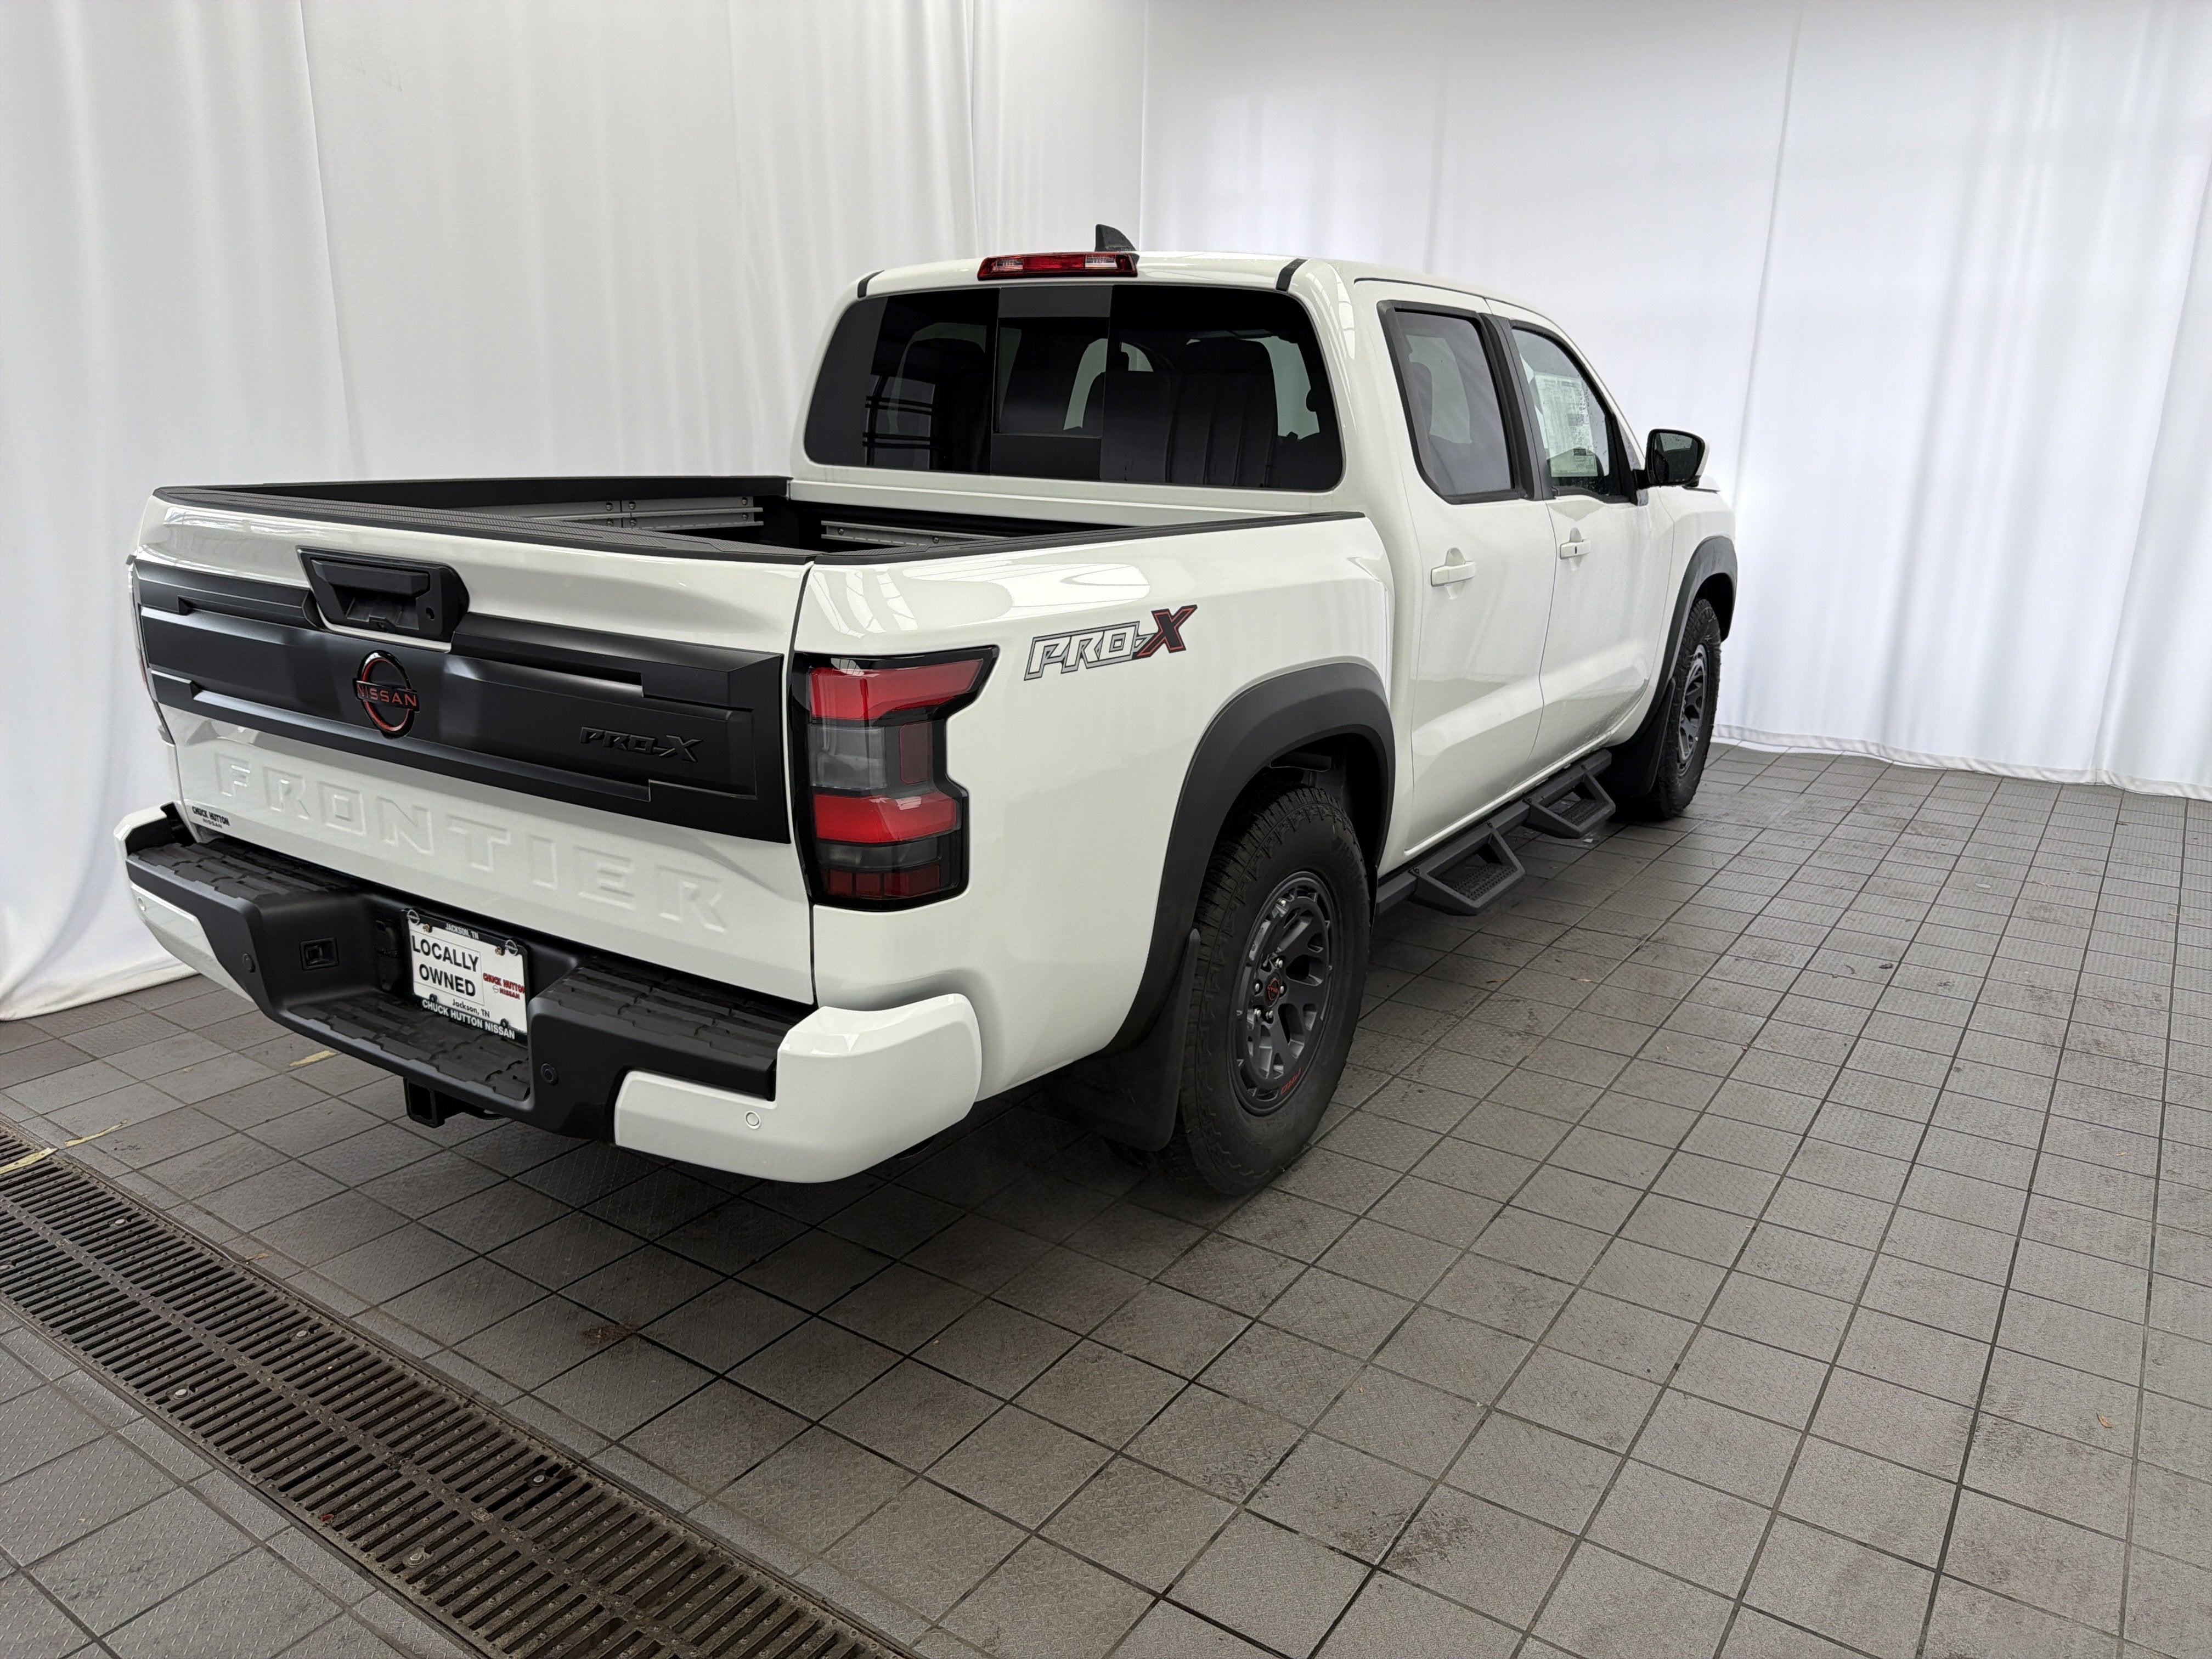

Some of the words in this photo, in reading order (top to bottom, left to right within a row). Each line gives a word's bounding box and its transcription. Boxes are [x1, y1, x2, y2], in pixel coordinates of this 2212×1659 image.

[1023, 604, 1198, 681] PRO-X
[357, 684, 417, 707] NISSAN
[579, 726, 704, 763] PRO-X
[214, 753, 726, 933] FRONTIER
[445, 922, 471, 938] JACKSON,
[471, 930, 479, 940] TN
[411, 935, 479, 972] LOCALLY
[419, 963, 476, 997] OWNED
[422, 998, 449, 1017] CHUCK
[450, 1009, 483, 1029] HUTTON
[484, 1021, 515, 1040] NISSAN
[452, 998, 480, 1015] Jackson,
[481, 1008, 490, 1019] TN
